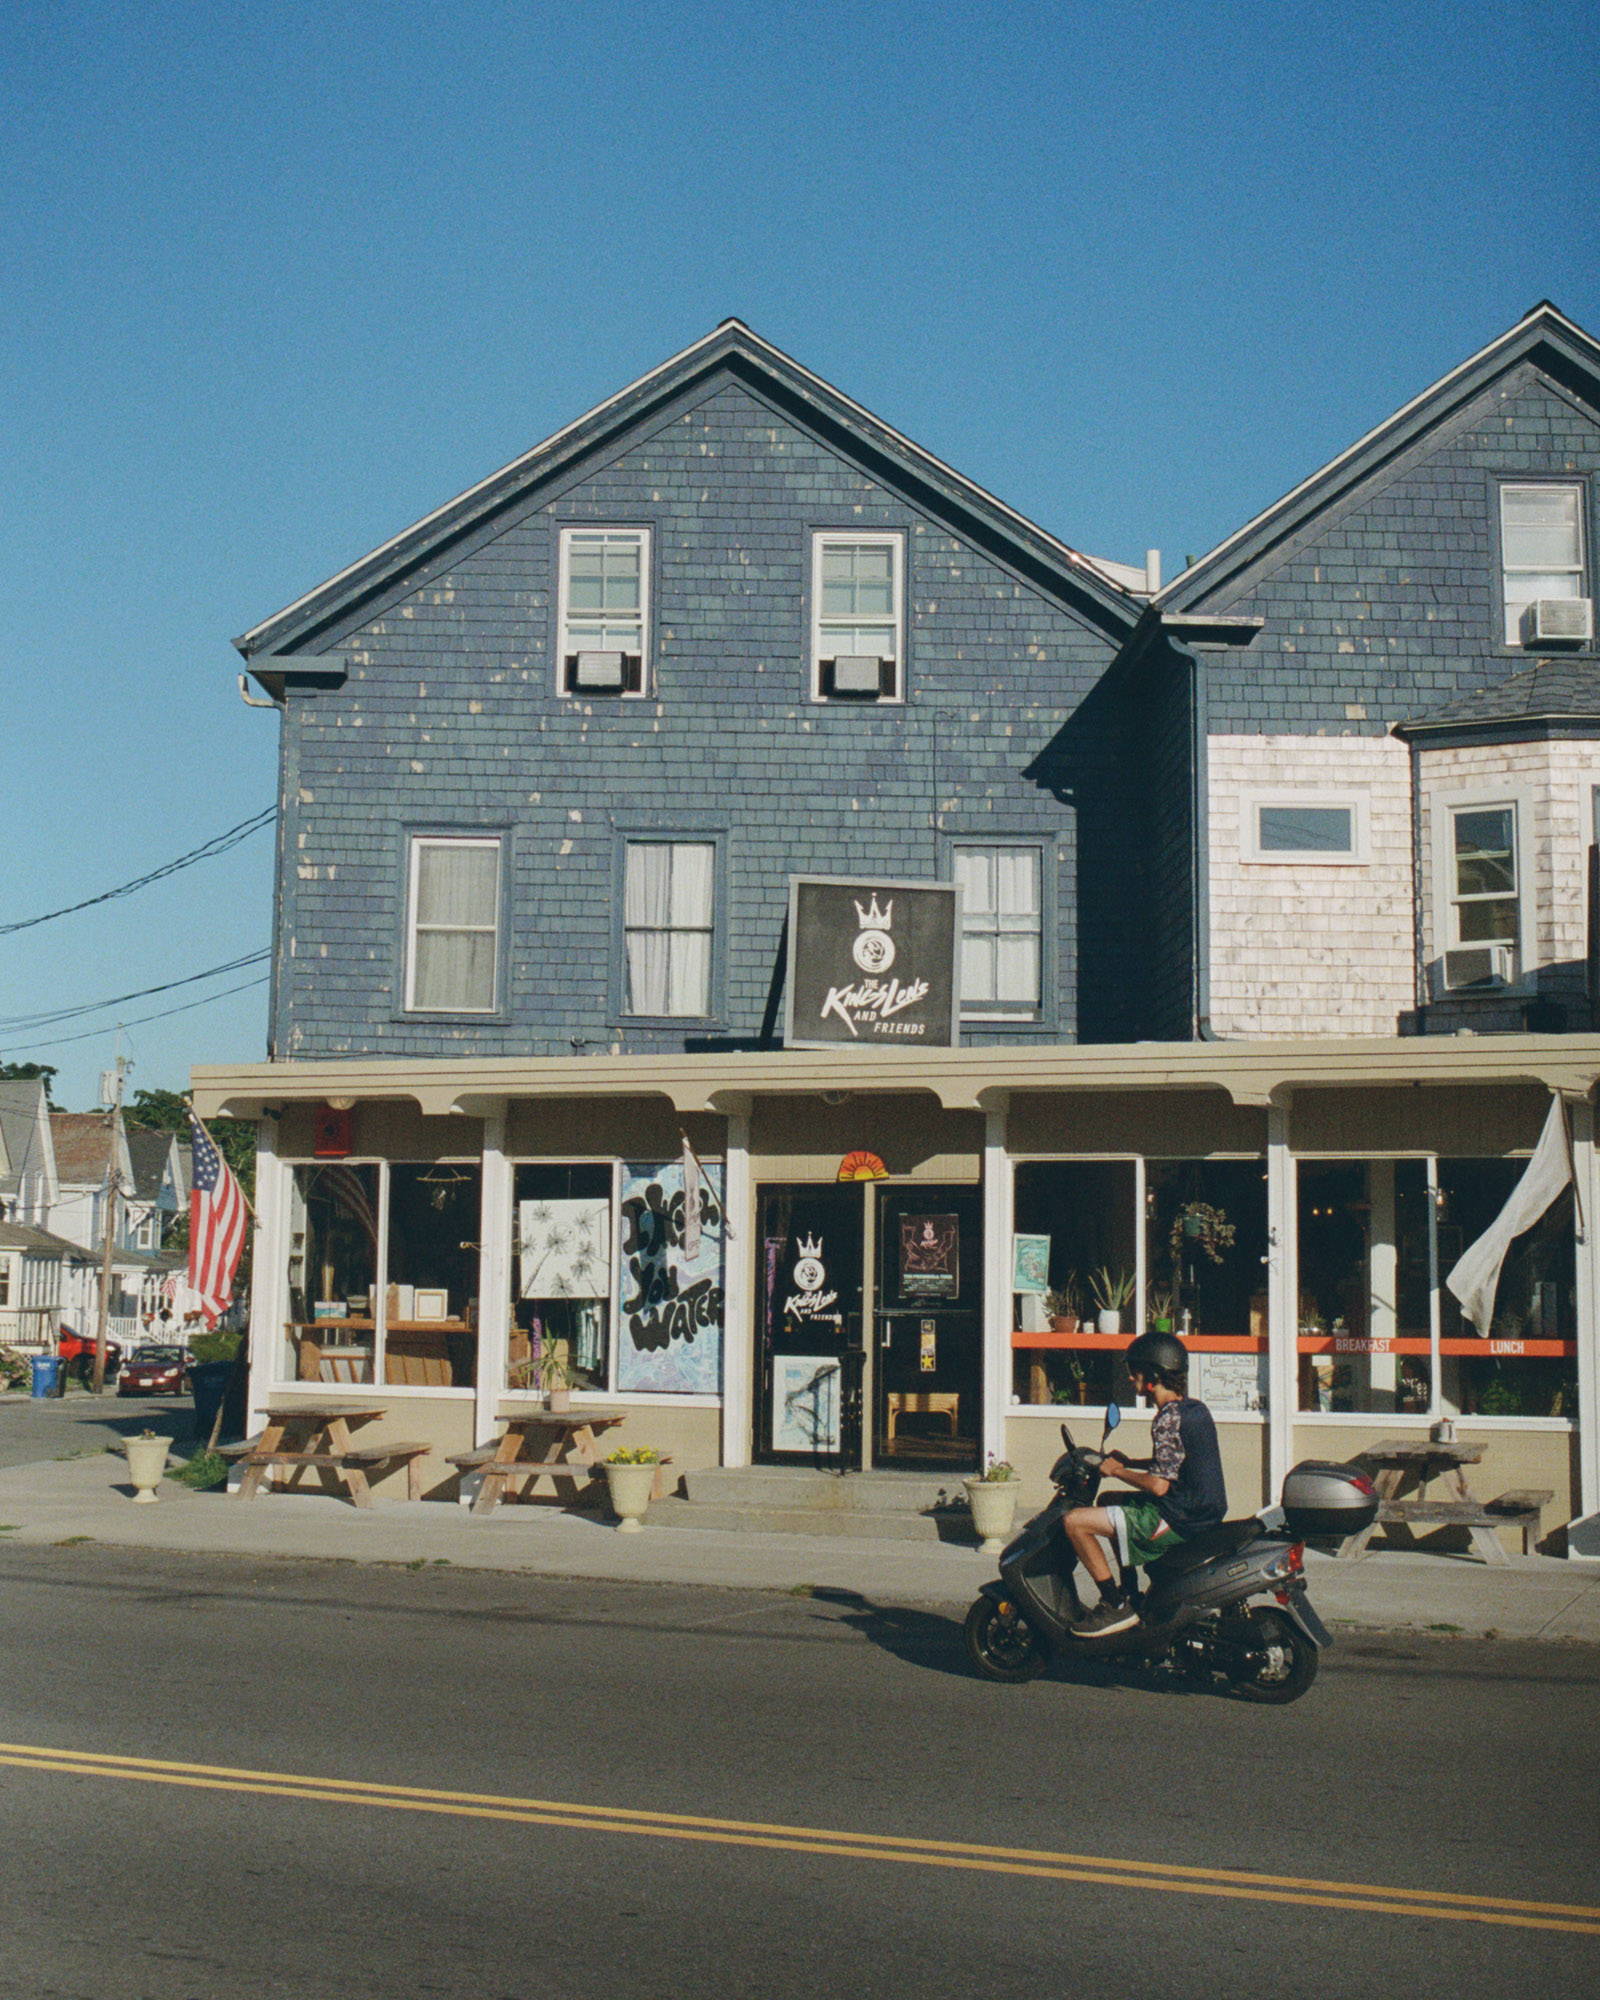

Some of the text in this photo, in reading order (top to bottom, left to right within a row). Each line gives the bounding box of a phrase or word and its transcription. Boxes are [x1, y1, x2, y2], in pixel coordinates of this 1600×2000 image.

[863, 978, 880, 989] THE
[853, 1010, 878, 1021] AND
[873, 1021, 926, 1035] FRIENDS
[629, 1278, 725, 1352] WATER
[1335, 1338, 1391, 1352] BREAKFAST
[1490, 1340, 1525, 1354] LUNCH
